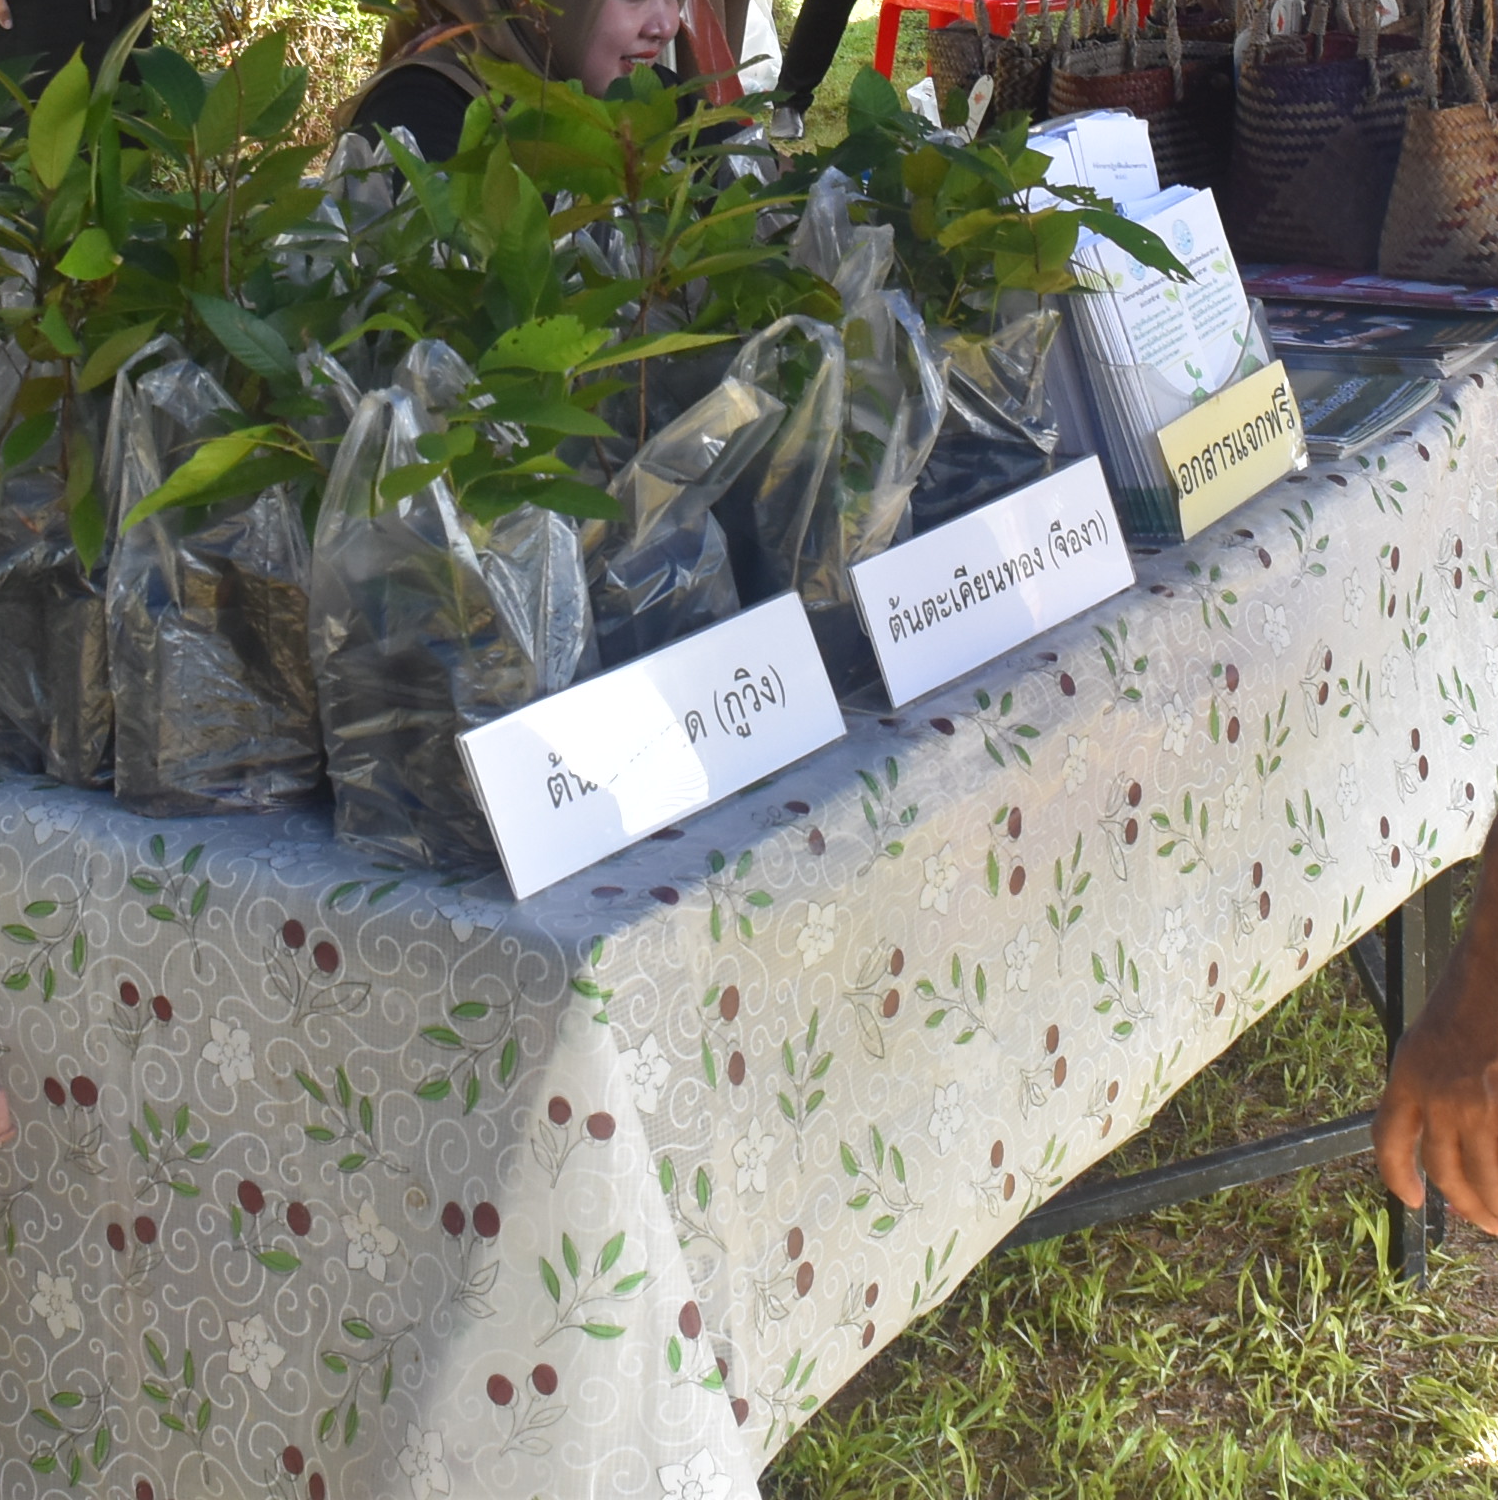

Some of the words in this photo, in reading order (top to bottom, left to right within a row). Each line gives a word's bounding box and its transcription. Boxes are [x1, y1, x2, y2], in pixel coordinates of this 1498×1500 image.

[888, 546, 1045, 643] ต้นตะเคียนทอง
[713, 664, 786, 739] (กูวิง)
